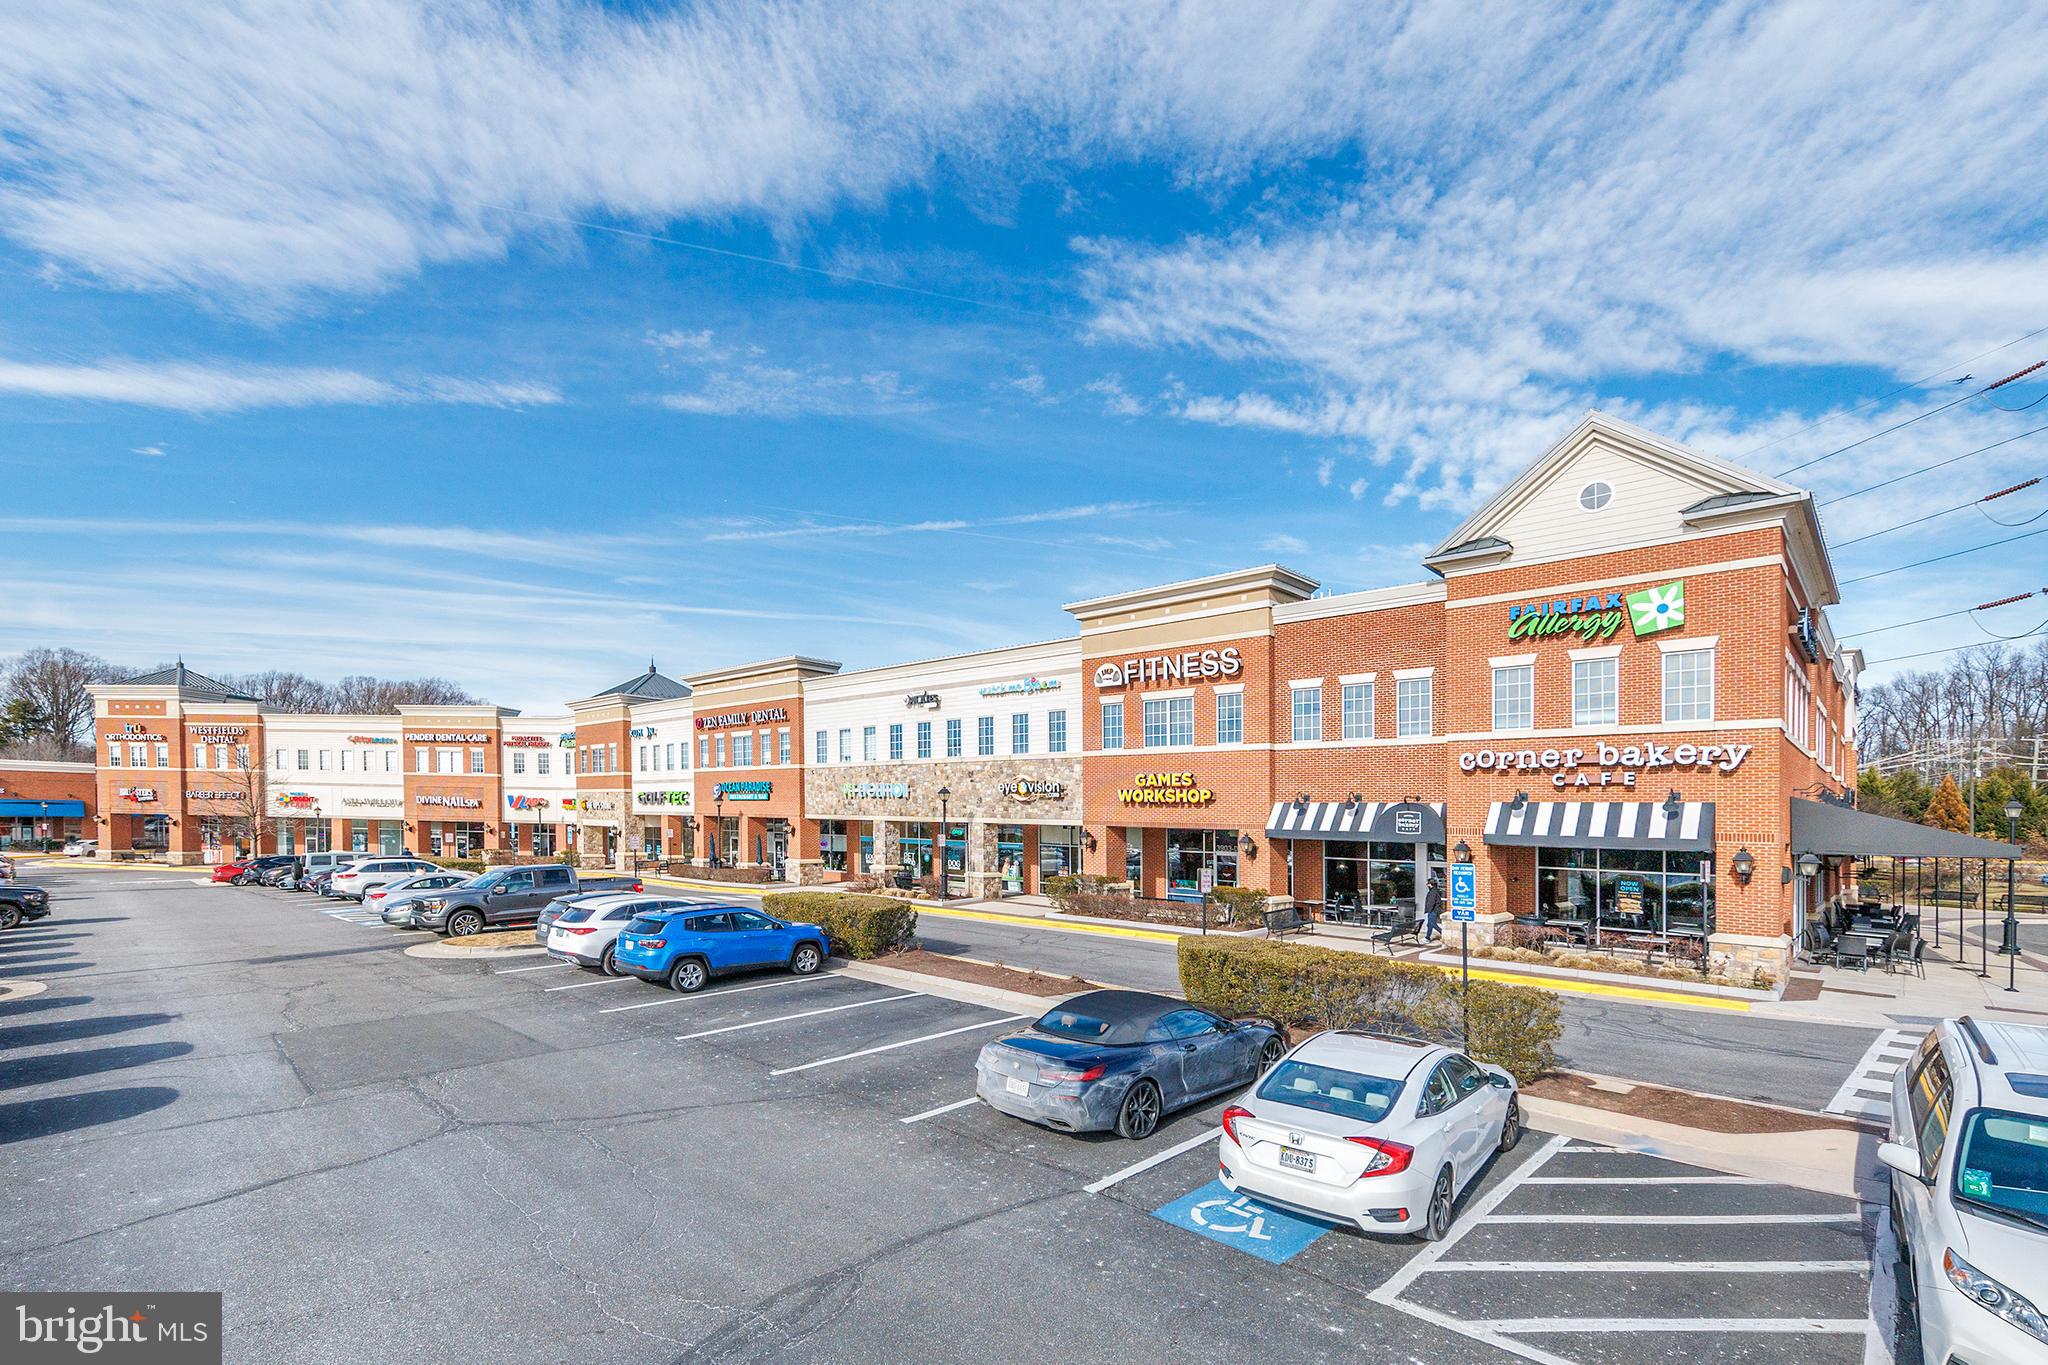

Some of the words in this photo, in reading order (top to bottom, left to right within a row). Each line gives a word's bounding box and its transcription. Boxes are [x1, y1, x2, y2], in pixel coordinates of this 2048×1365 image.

[1509, 592, 1623, 620] FAIRFAX
[1124, 647, 1241, 684] FITNESS
[702, 715, 718, 726] ZEN
[719, 712, 747, 727] FAMILY
[751, 708, 786, 722] DENTAL
[189, 727, 245, 735] WESTFIELDS
[404, 733, 434, 741] PENDER
[436, 733, 465, 741] DENTAL
[466, 734, 487, 742] CARE
[201, 736, 235, 744] DENTAL
[1459, 748, 1583, 771] corner
[1596, 741, 1753, 770] bakery
[1135, 773, 1194, 787] GAMES
[1551, 772, 1636, 787] CAFE
[721, 782, 740, 792] OCEAN
[741, 782, 770, 792] PARADISE
[998, 783, 1017, 795] eye
[1028, 780, 1060, 792] vision
[186, 791, 213, 799] BARBER
[416, 795, 442, 803] DIVINE
[442, 796, 465, 806] NAIL
[465, 798, 480, 807] SPA
[1118, 789, 1213, 804] WORKSHOP
